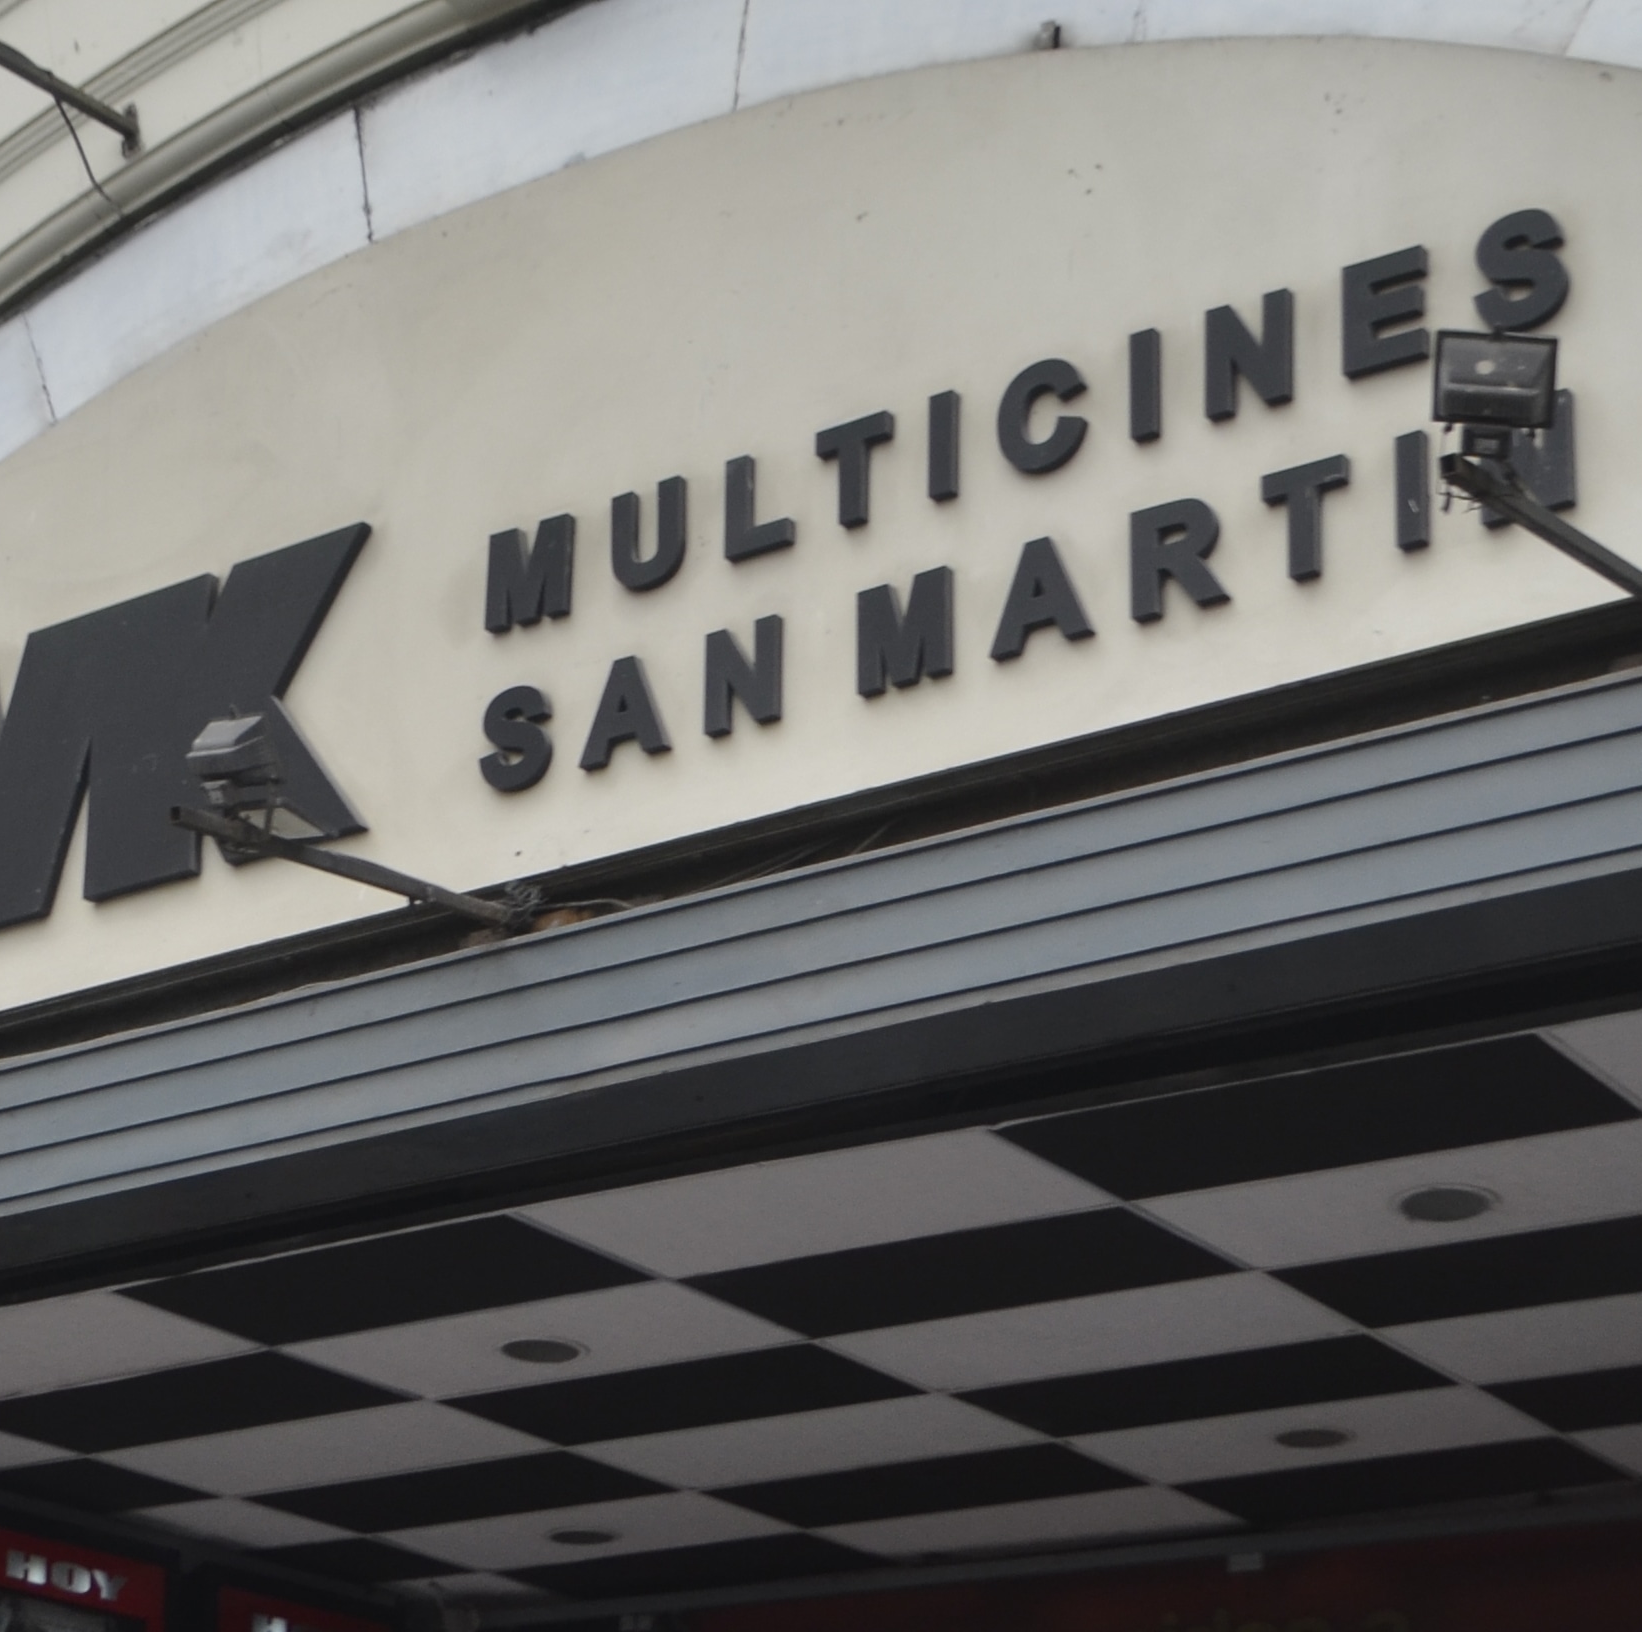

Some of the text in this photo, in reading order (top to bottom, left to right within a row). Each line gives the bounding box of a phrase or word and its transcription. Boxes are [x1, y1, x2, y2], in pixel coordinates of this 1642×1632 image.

[484, 207, 1571, 634] MULTICINES
[478, 606, 784, 793] SAN
[5, 1549, 130, 1601] HOY
